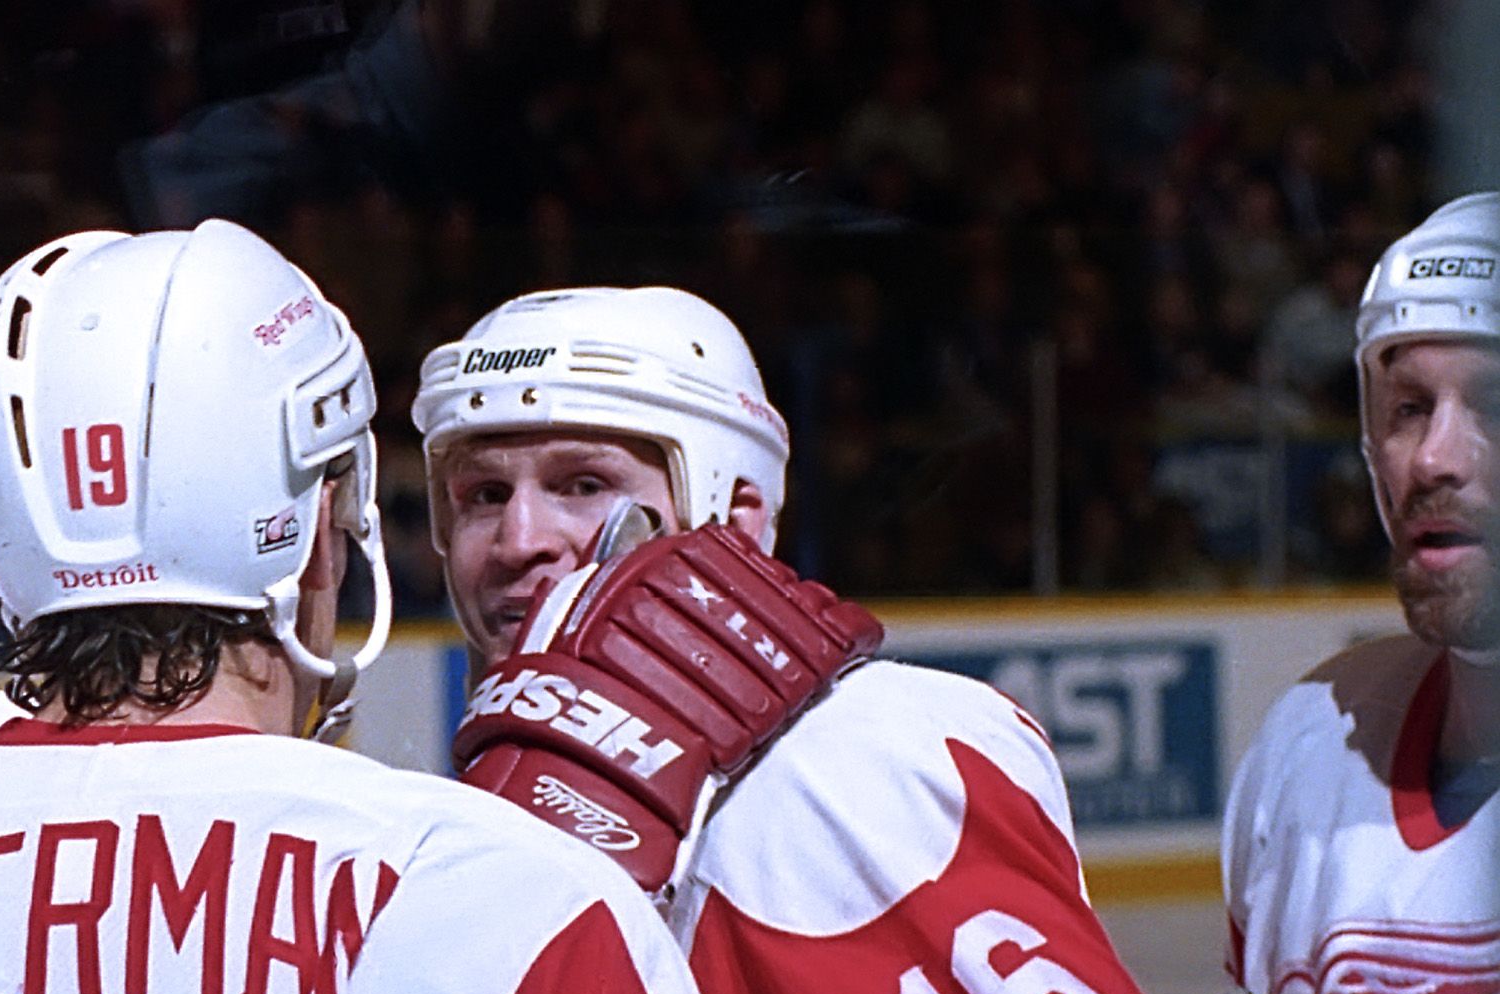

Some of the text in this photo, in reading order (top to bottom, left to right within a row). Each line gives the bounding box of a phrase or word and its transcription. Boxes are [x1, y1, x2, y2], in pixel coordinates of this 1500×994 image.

[1408, 257, 1494, 278] CCM
[462, 345, 557, 374] Cooper
[62, 424, 129, 511] 19
[53, 563, 159, 590] Detroit
[676, 575, 790, 671] RTX
[463, 668, 684, 779] HESP
[532, 775, 641, 853] Classic
